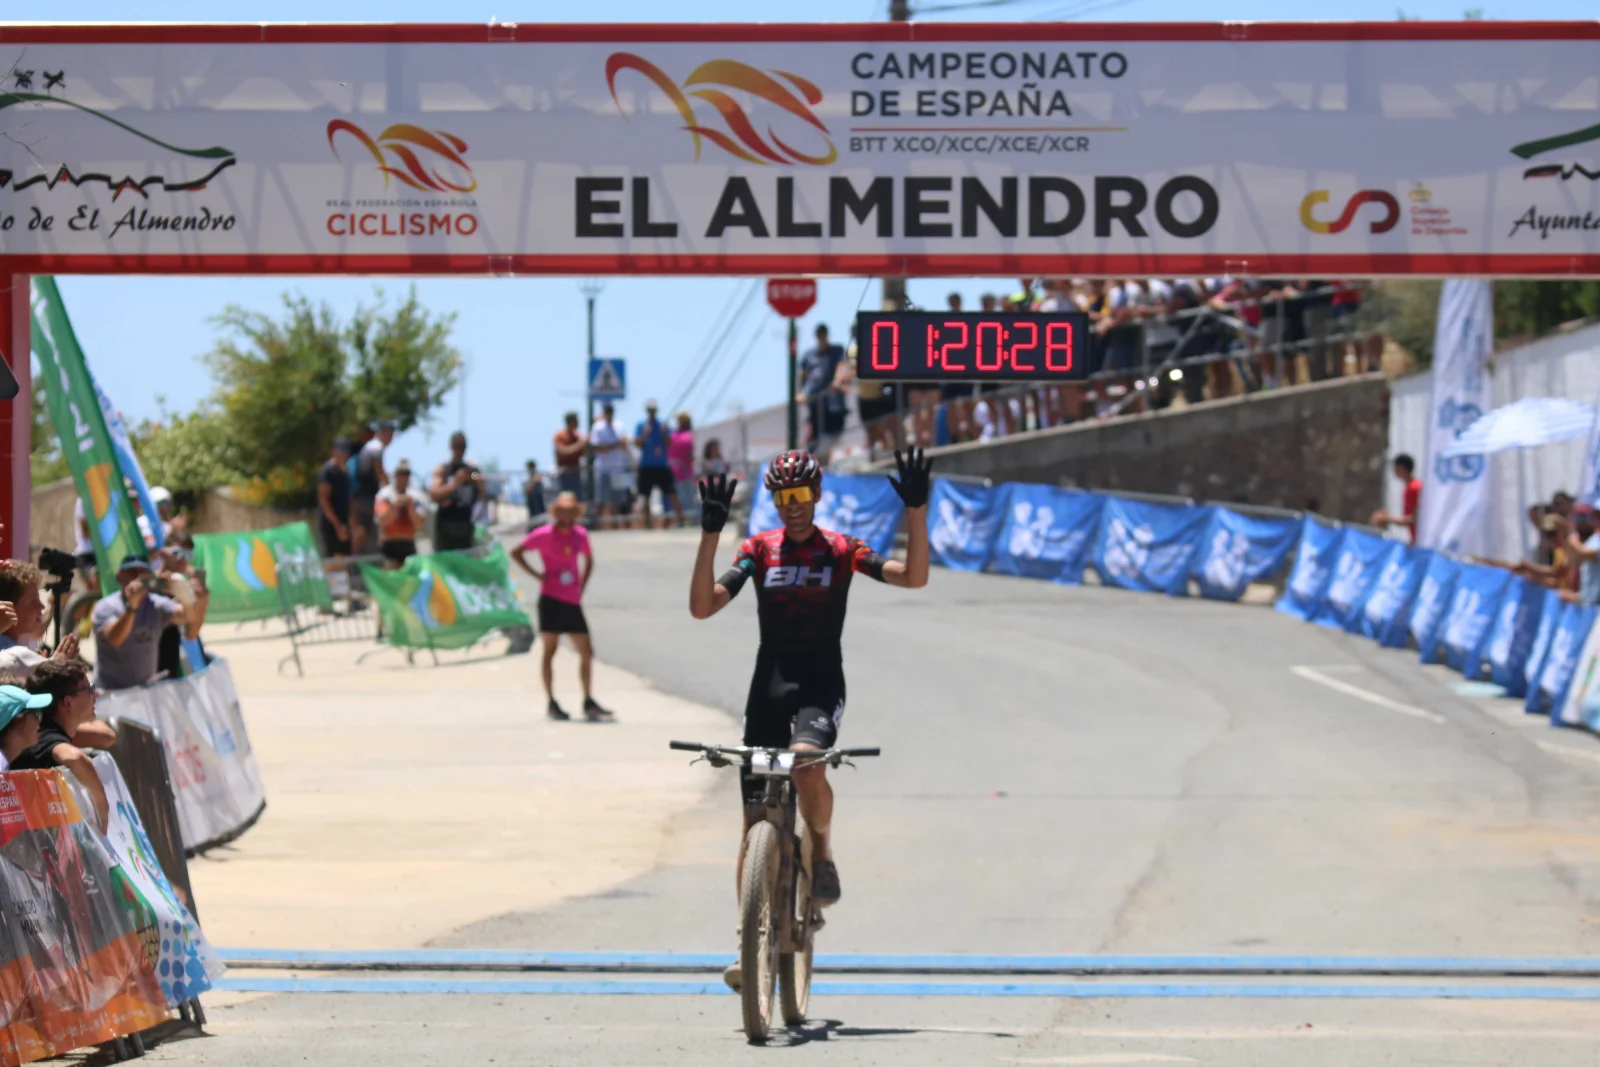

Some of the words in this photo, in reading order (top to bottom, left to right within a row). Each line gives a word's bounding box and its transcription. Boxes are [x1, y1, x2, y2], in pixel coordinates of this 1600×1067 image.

[850, 51, 1129, 80] CAMPEONATO
[851, 92, 901, 118] DE
[915, 82, 1073, 118] ESPAÑA
[849, 137, 888, 152] BTT
[892, 136, 1090, 155] XCO/XCC/XCE/XCR
[575, 176, 678, 238] EL
[705, 175, 1220, 239] ALMENDRO
[27, 206, 55, 232] de
[67, 204, 100, 232] El
[108, 206, 237, 239] Almendro
[326, 213, 478, 237] CICLISMO
[770, 284, 815, 299] STOP
[763, 565, 833, 588] BH
